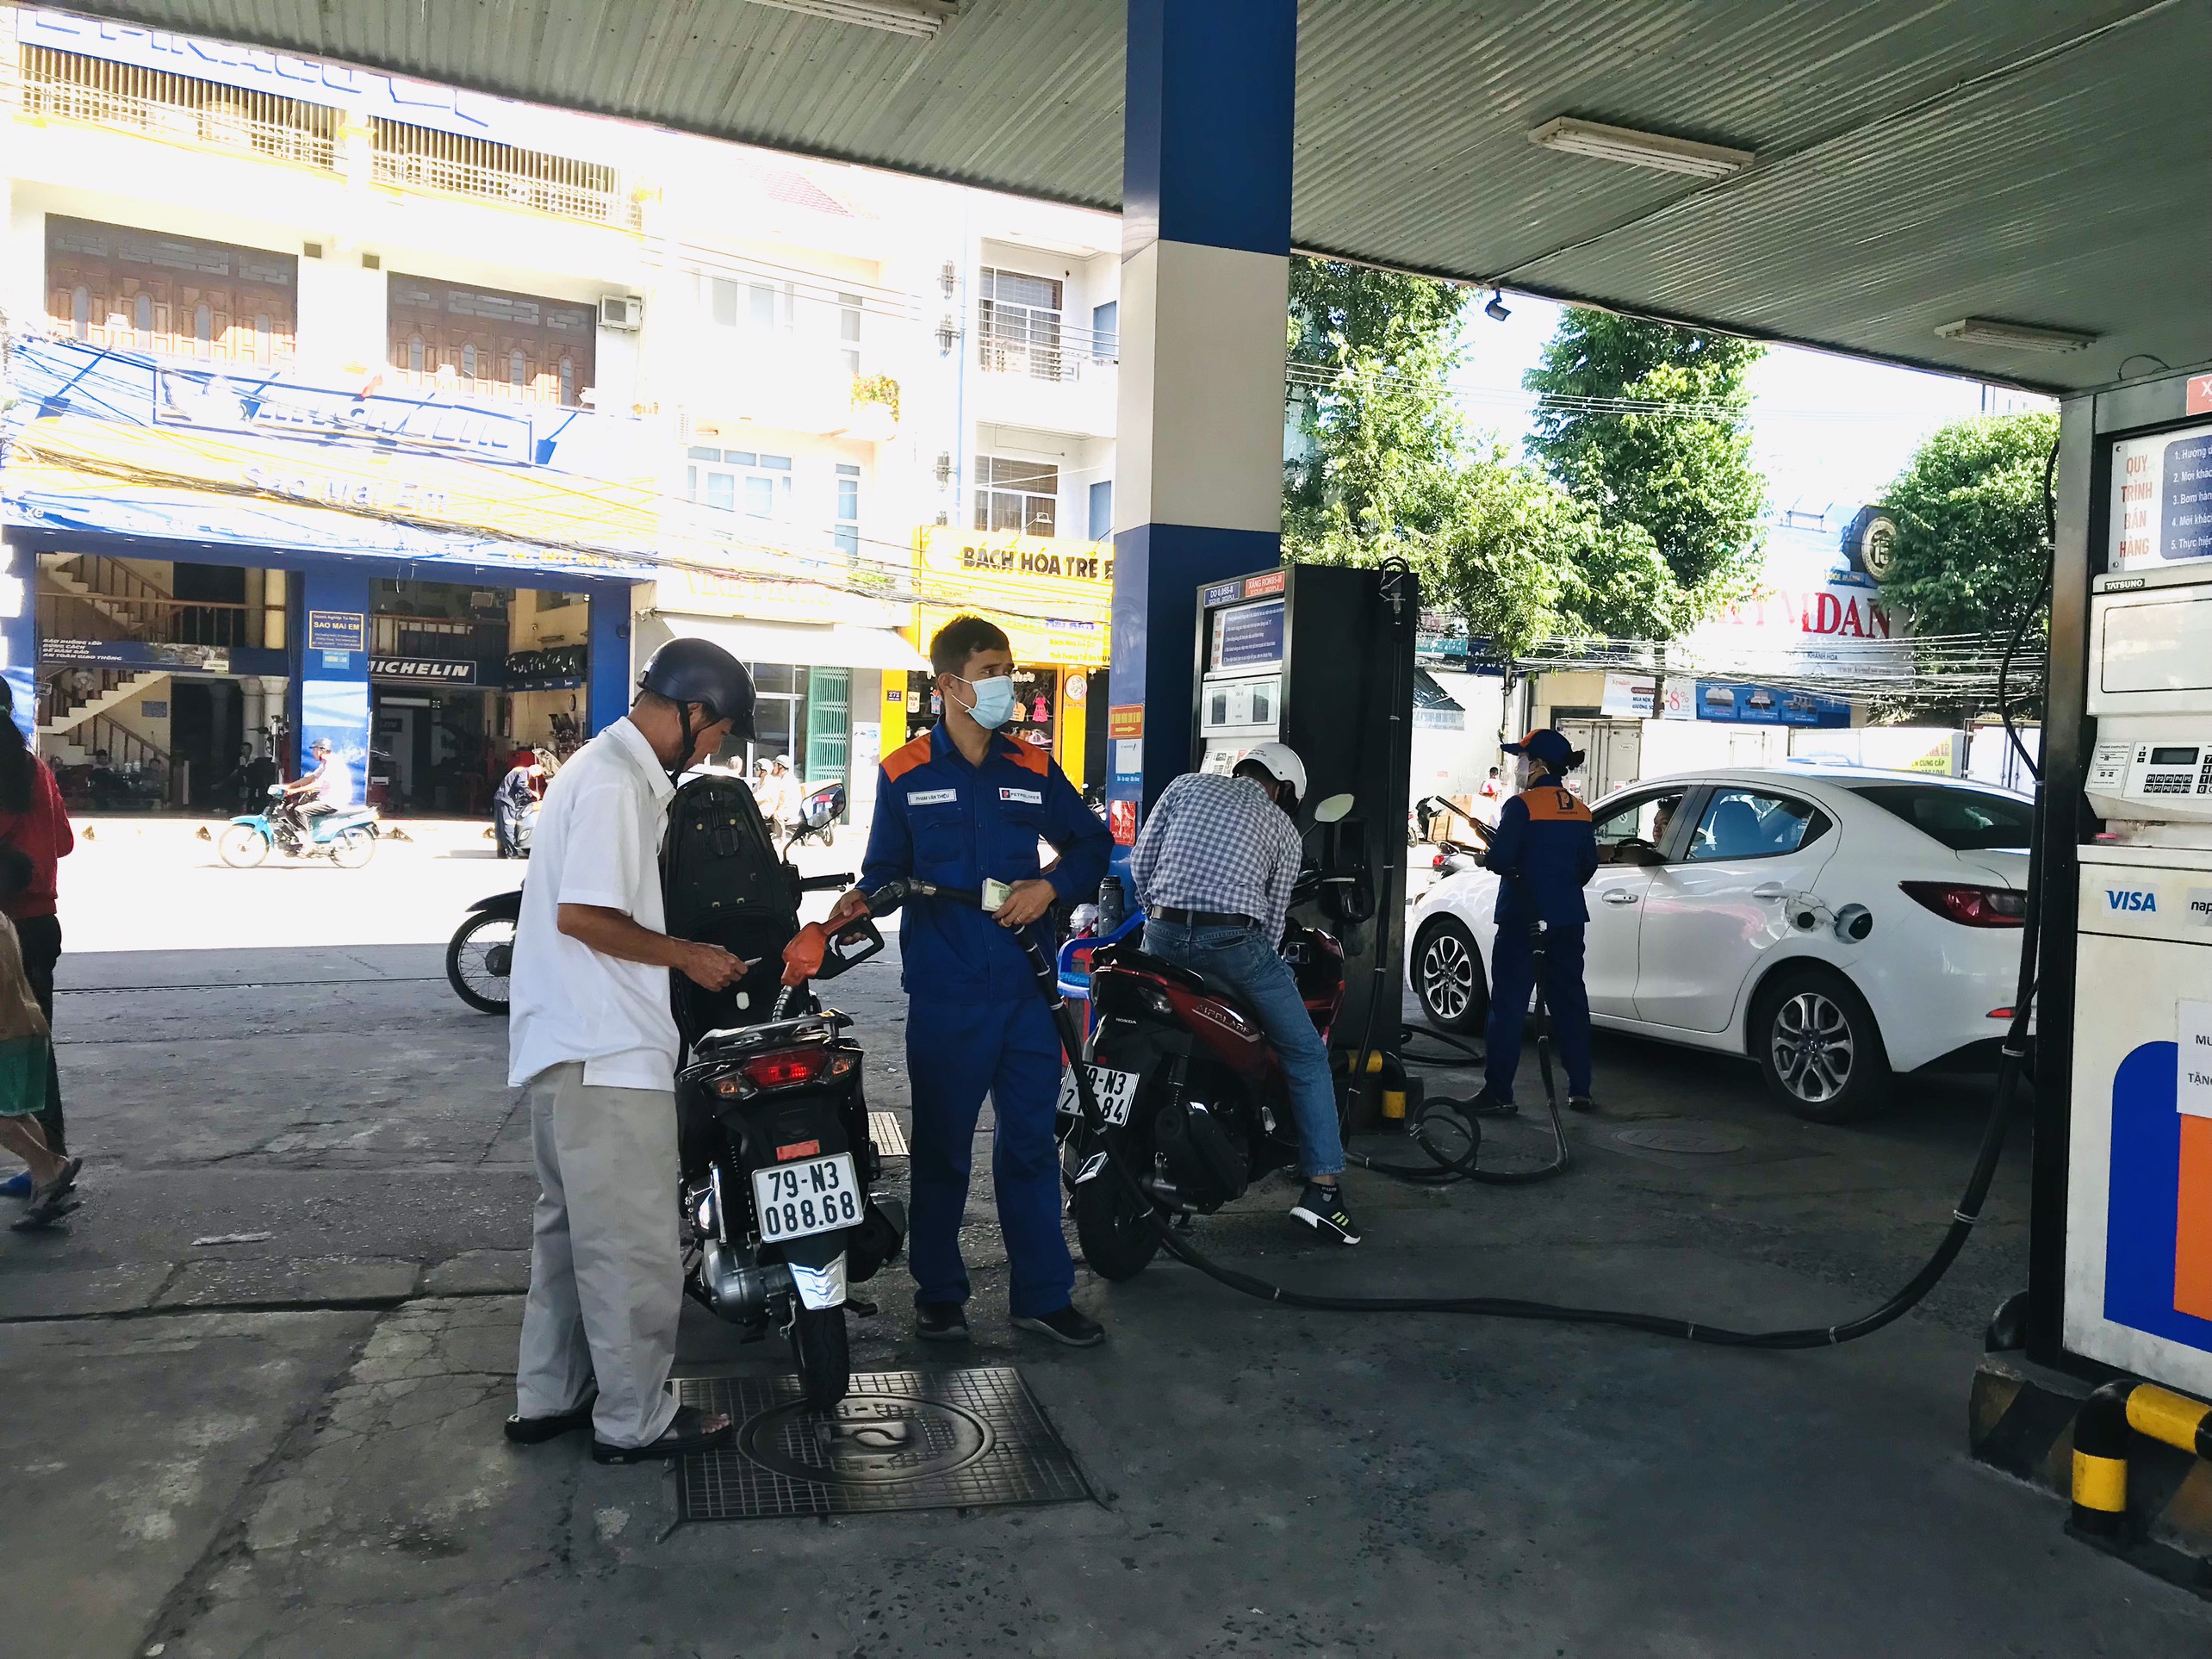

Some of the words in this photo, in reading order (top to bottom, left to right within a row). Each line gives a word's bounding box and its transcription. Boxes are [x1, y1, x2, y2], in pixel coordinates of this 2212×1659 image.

[2126, 454, 2148, 476] QUY
[2173, 472, 2180, 482] 2.
[2122, 479, 2153, 503] TRÌNH
[2172, 494, 2179, 506] 3.
[2124, 506, 2147, 530] BÁN
[2119, 536, 2150, 557] HÀNG
[1021, 547, 1060, 575] HÓA
[2105, 579, 2143, 590] TATSUNO
[2104, 890, 2157, 912] VISA
[2190, 901, 2212, 915] nap
[767, 1161, 839, 1202] 79-N3
[765, 1190, 855, 1236] 088.68
